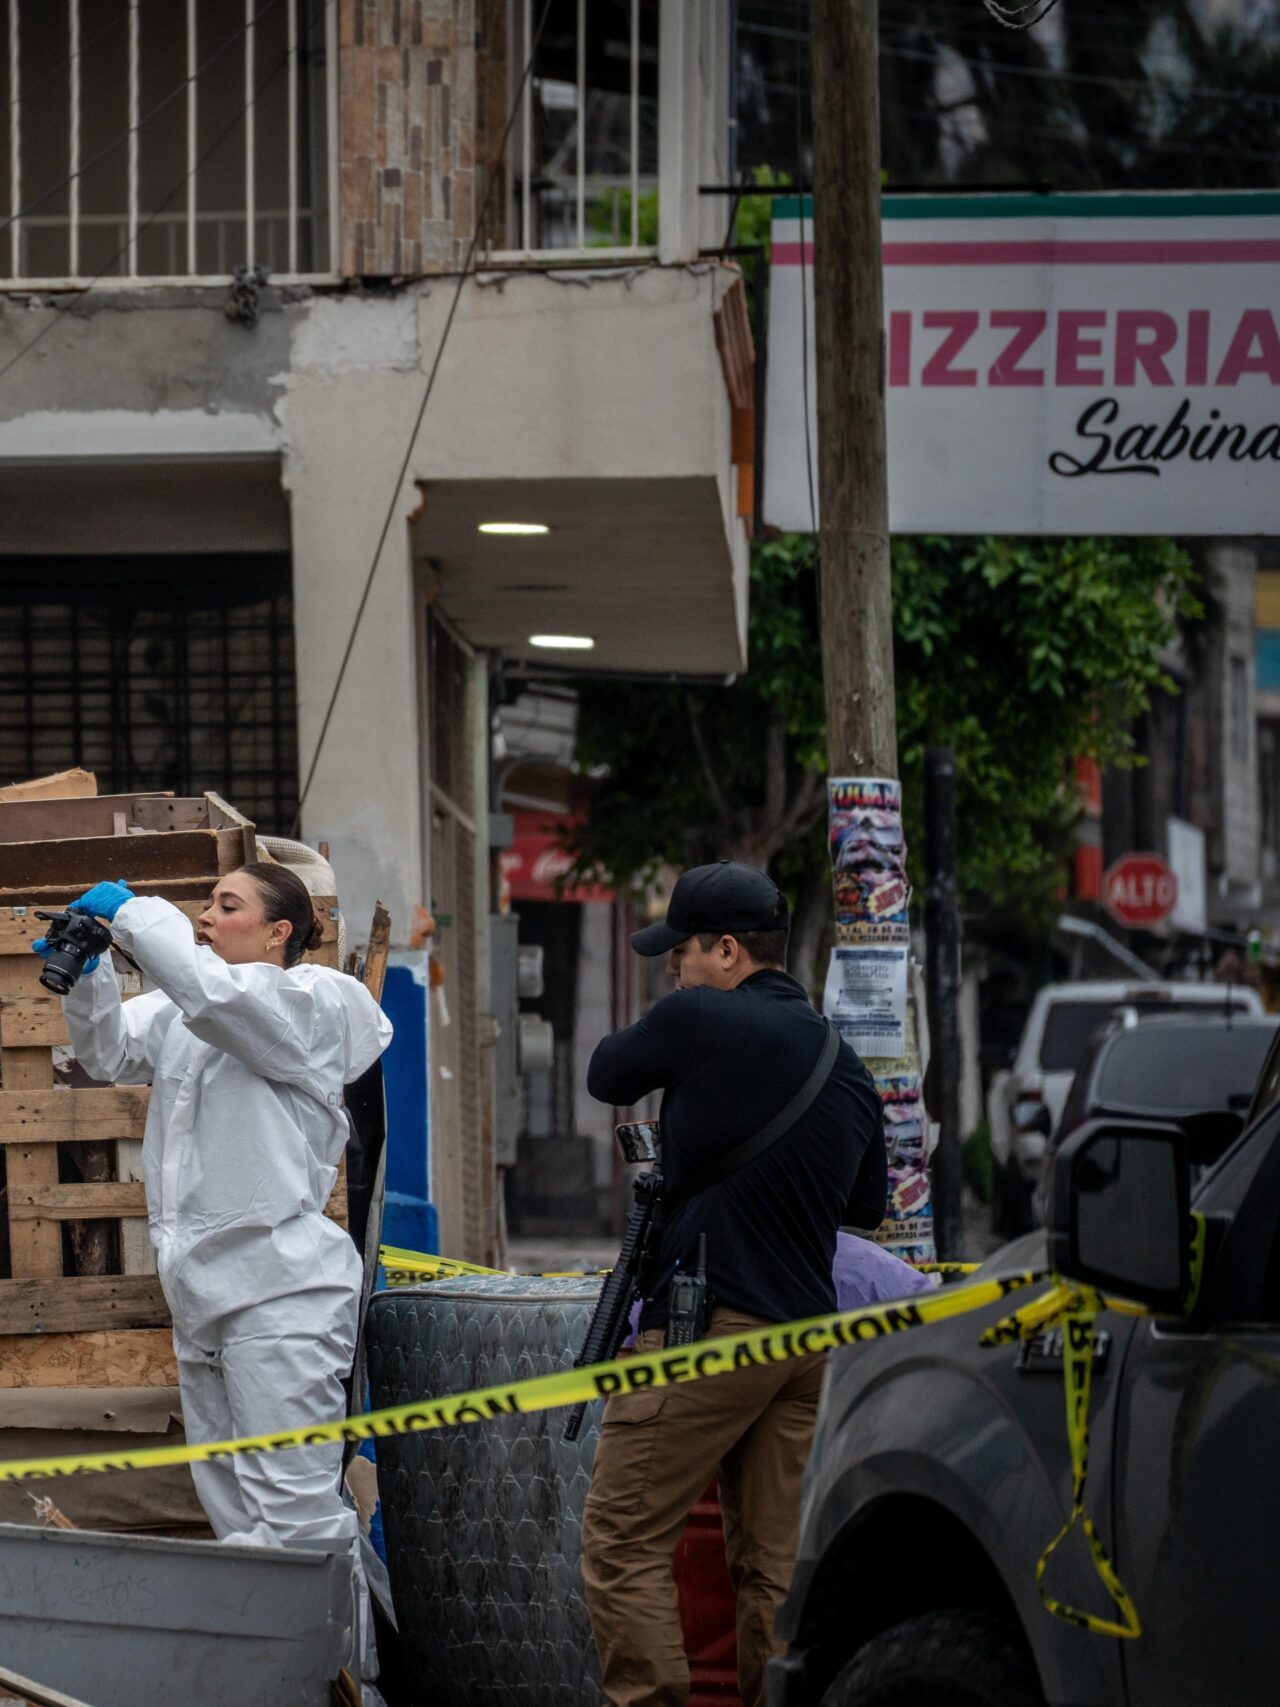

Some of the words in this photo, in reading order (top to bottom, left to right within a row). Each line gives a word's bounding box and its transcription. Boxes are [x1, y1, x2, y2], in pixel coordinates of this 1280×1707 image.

[887, 309, 1280, 387] IZZERIA
[1049, 397, 1280, 477] Sabina
[1110, 873, 1176, 908] ALTO
[207, 1394, 521, 1460] AUCIÓN
